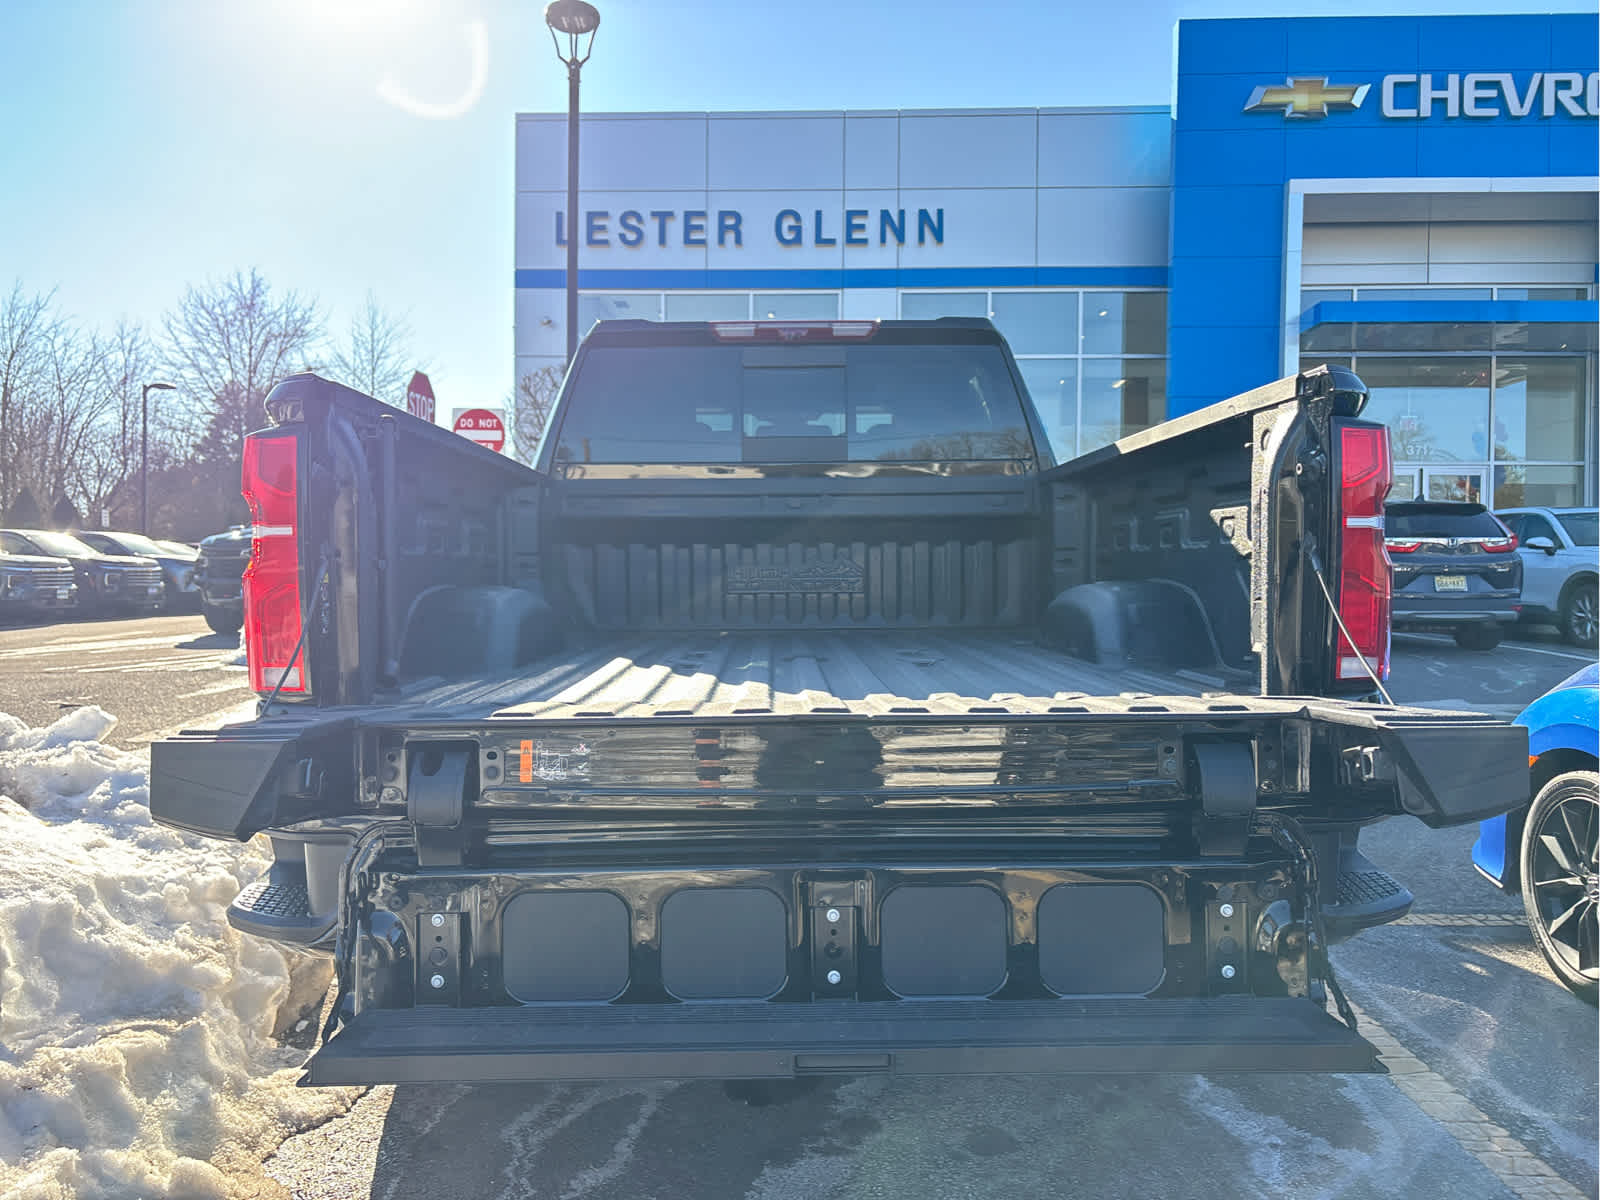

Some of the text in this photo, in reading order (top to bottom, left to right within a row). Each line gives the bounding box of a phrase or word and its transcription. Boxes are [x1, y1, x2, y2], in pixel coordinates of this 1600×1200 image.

[556, 208, 945, 247] LESTER GLENN
[408, 391, 434, 423] STOP
[460, 418, 498, 428] DO NOT
